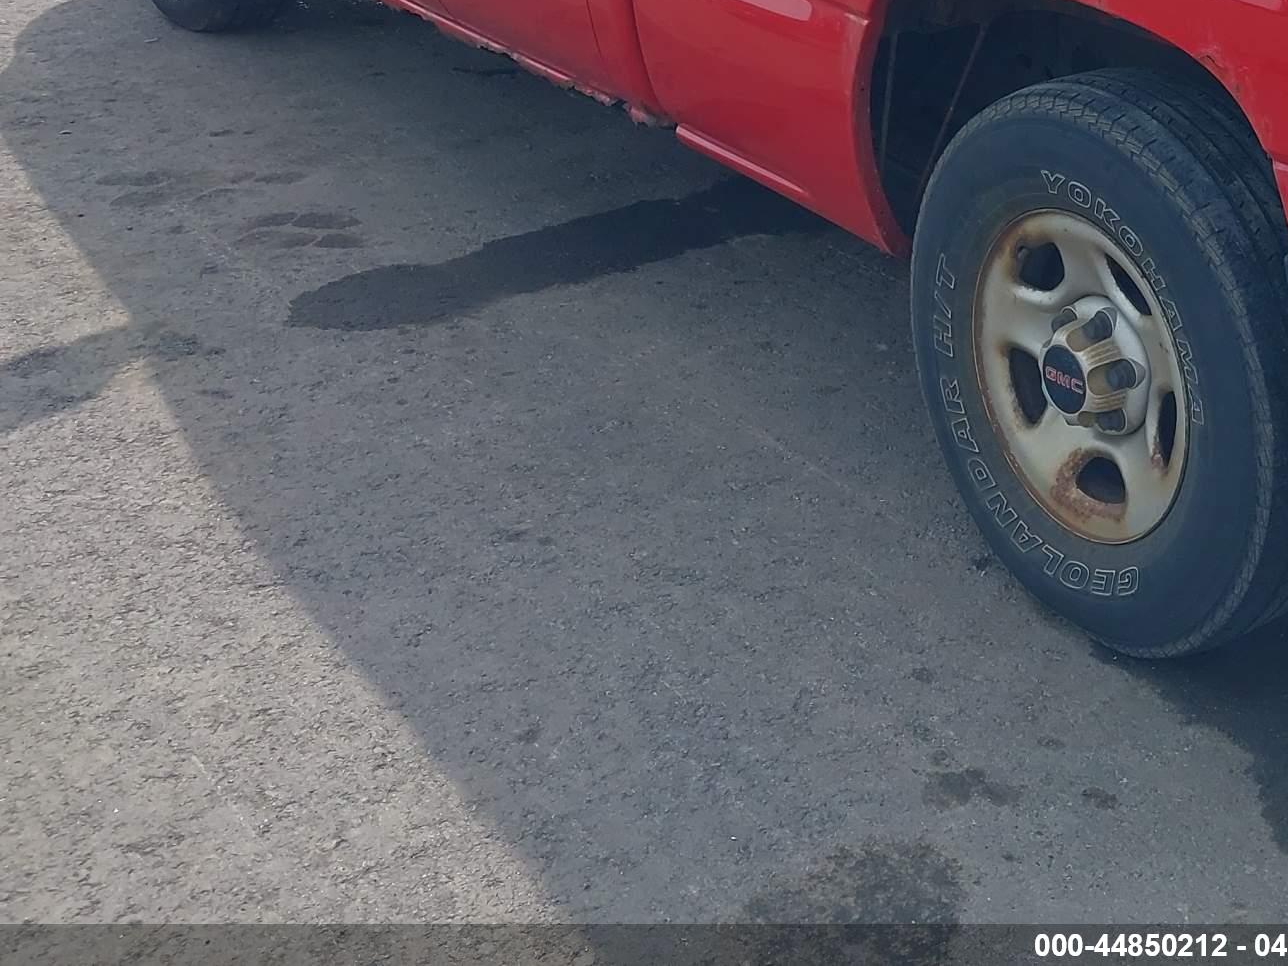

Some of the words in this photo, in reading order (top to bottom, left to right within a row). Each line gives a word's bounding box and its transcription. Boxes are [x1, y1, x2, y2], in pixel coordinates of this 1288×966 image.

[933, 253, 956, 356] H/T
[1041, 170, 1204, 425] YOKOHAMA
[1045, 365, 1084, 395] GMC
[938, 378, 1140, 596] GEOLANDAR
